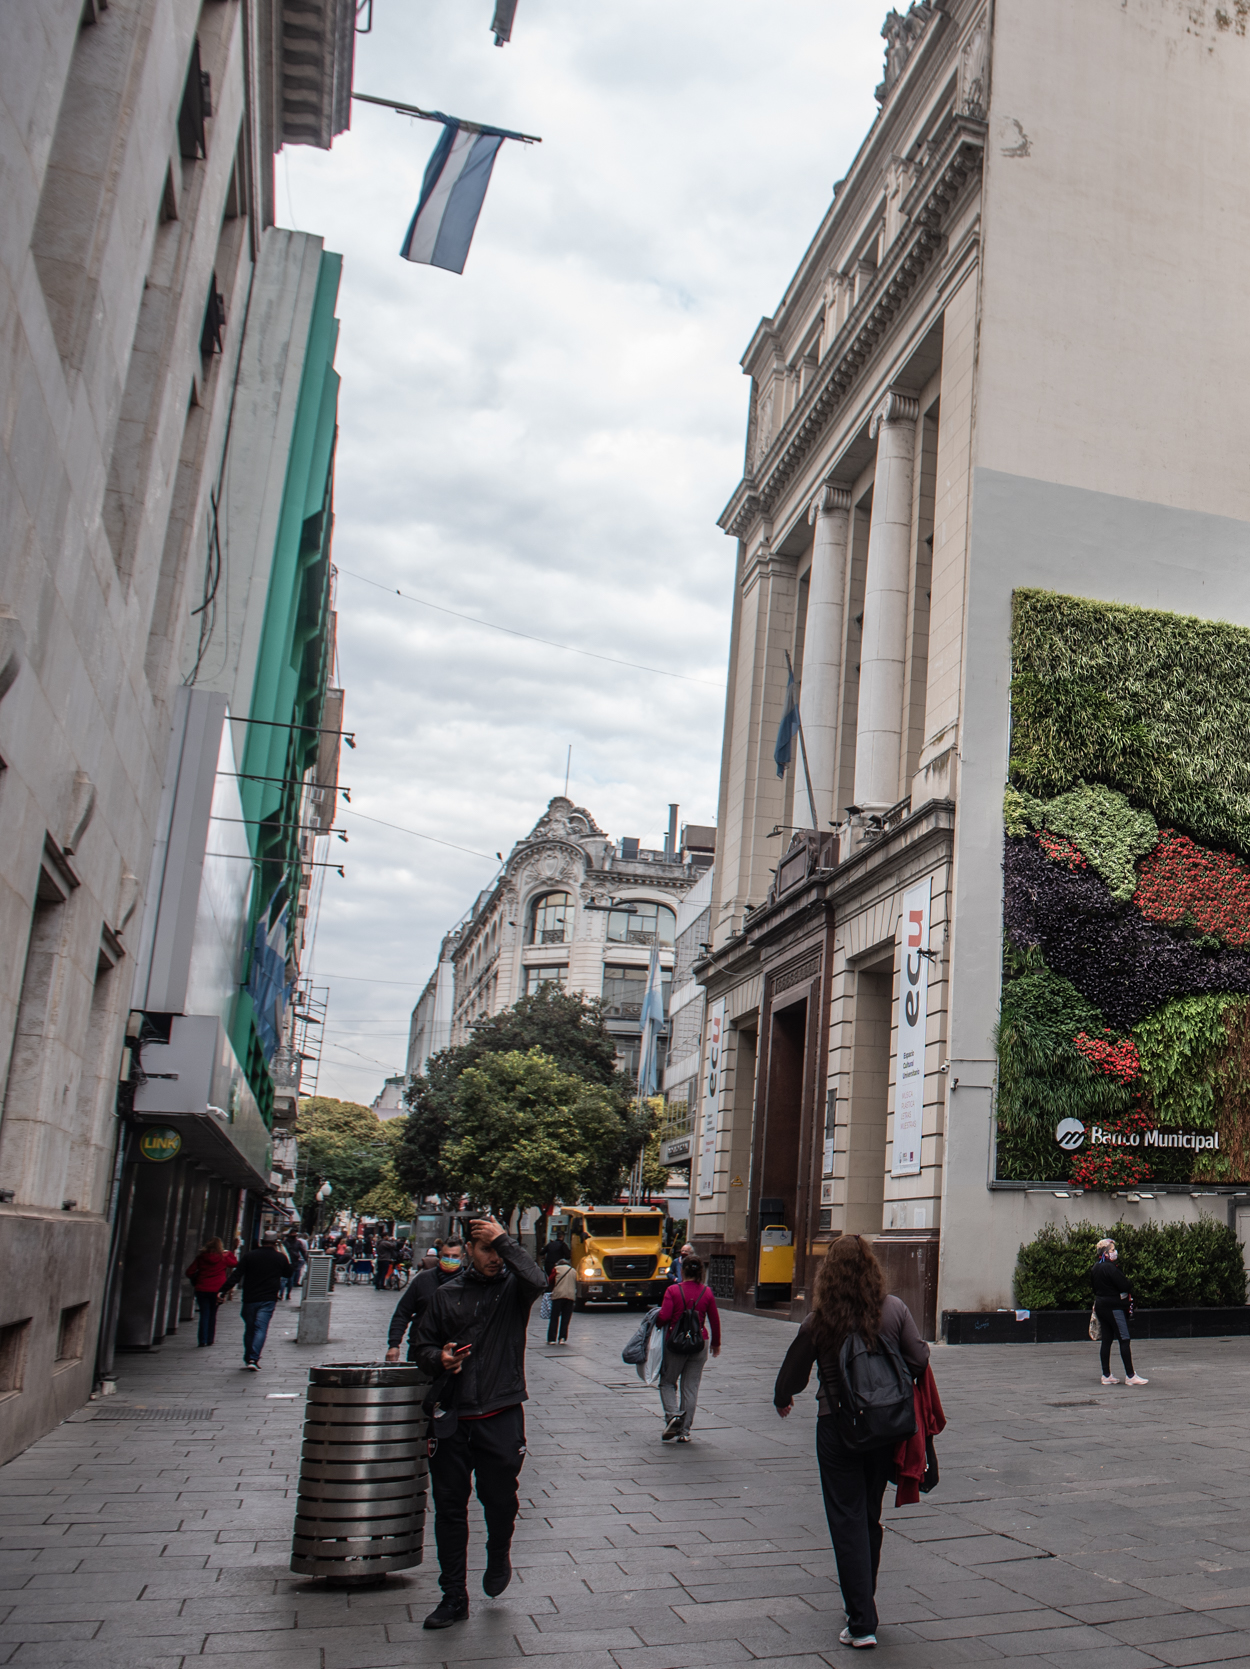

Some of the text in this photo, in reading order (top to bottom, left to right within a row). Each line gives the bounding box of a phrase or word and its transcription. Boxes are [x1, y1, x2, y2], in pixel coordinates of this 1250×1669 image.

[905, 909, 923, 1027] ecu
[709, 1016, 721, 1098] ecu
[144, 1134, 179, 1149] LINK
[1091, 1126, 1220, 1153] Banco Municipal
